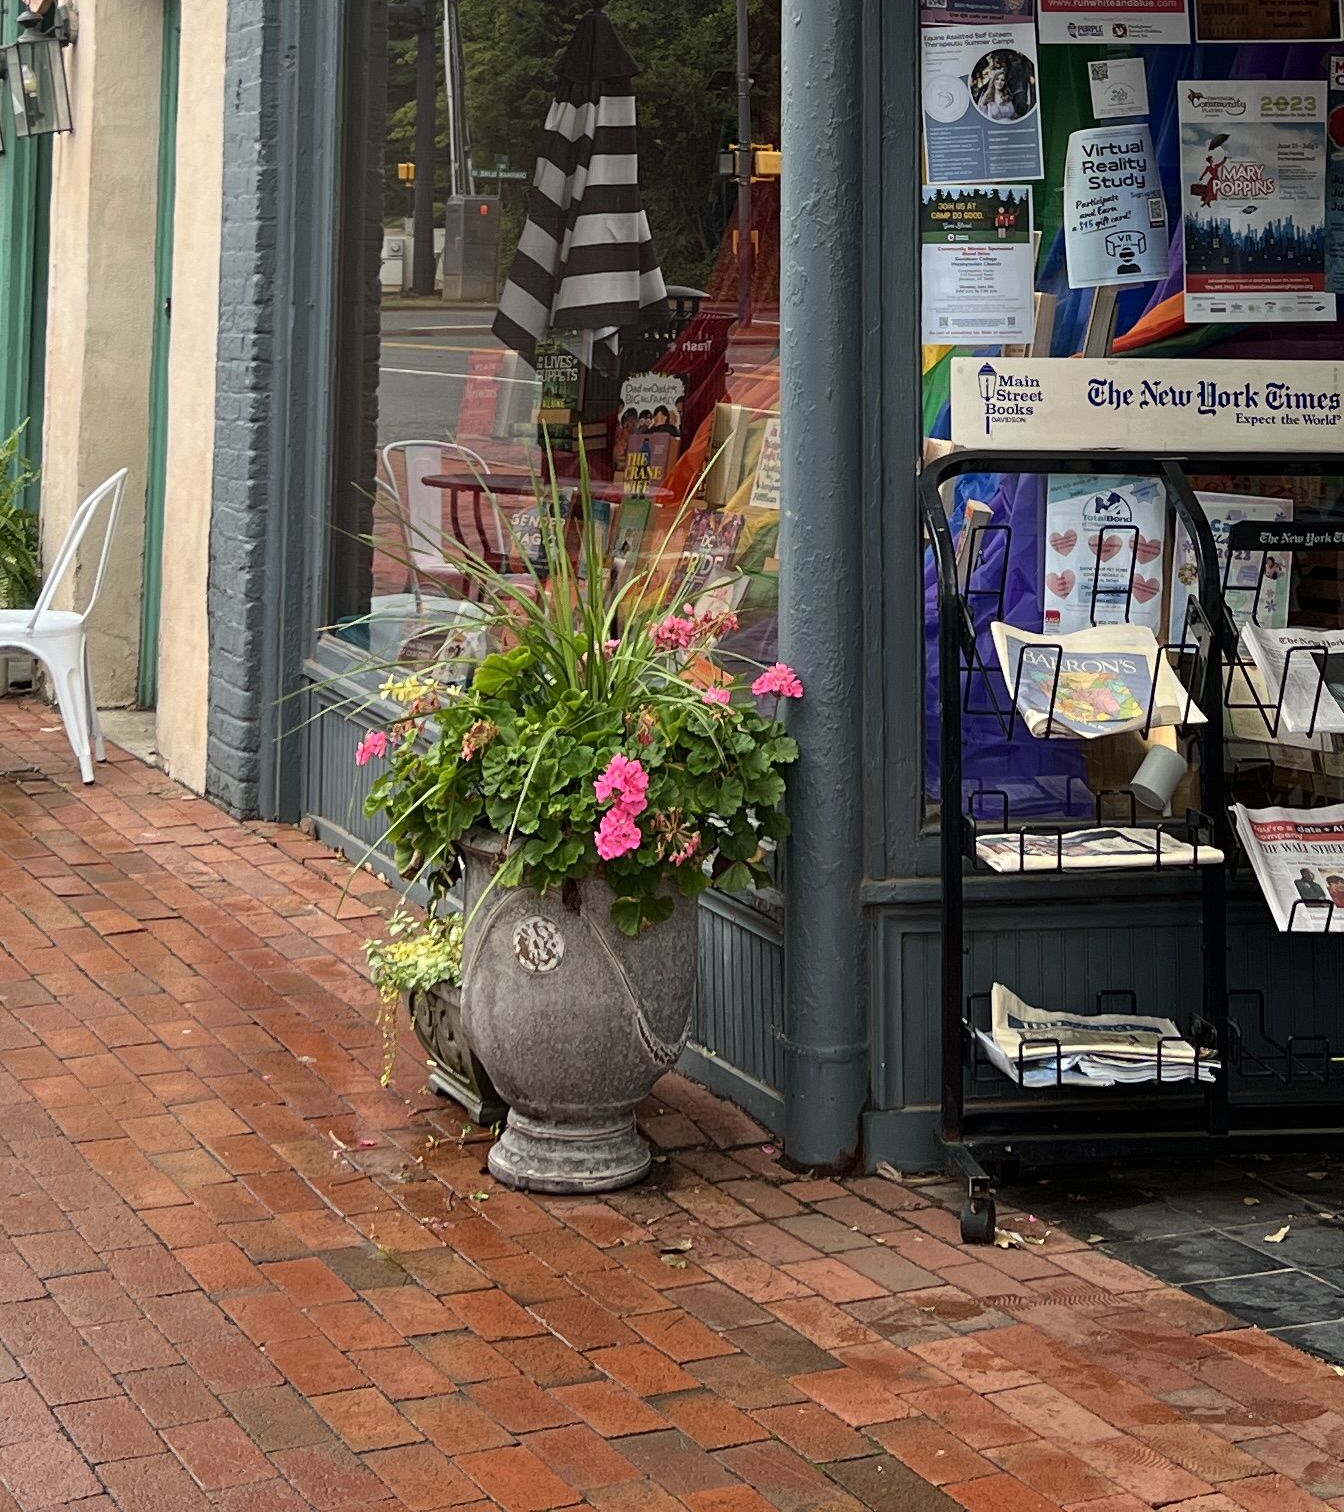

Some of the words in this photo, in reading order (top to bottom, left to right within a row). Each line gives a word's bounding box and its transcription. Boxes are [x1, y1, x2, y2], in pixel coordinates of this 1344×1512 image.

[974, 31, 987, 39] Self
[1078, 25, 1104, 34] PURPLE
[924, 40, 963, 48] Therapeutic
[991, 38, 1015, 47] Camps
[1260, 95, 1317, 111] 2023
[1081, 139, 1145, 158] Virtual
[1082, 157, 1147, 174] Reality
[1220, 164, 1265, 181] MARY
[1088, 173, 1146, 190] Study
[1212, 178, 1276, 199] POPPINS
[937, 202, 955, 210] JOIN
[956, 202, 966, 210] US
[967, 202, 977, 210] AT
[1075, 194, 1119, 210] Participate
[930, 211, 951, 220] CAMP
[952, 212, 963, 220] DO
[1080, 210, 1096, 219] and
[1097, 206, 1118, 217] Earn
[1079, 219, 1094, 231] $15
[1095, 217, 1110, 230] gift
[544, 355, 573, 369] LIVES
[535, 368, 579, 382] PUPPETS
[999, 375, 1040, 388] Main
[625, 383, 643, 394] Dad
[996, 388, 1044, 402] Street
[625, 394, 641, 405] BIG
[648, 394, 677, 405] FAMILY
[1087, 377, 1136, 411] The
[1139, 379, 1194, 411] New
[1196, 379, 1260, 417] York
[1264, 381, 1342, 412] Times
[985, 402, 1034, 416] Books
[1235, 412, 1276, 427] Expect
[1280, 413, 1301, 425] the
[626, 452, 649, 467] THE
[624, 465, 663, 481] CRANE
[623, 480, 652, 494] WIFE
[510, 513, 566, 530] GENDER
[1083, 514, 1132, 523] TotalBond
[1258, 532, 1275, 544] The
[1279, 532, 1304, 544] New
[1305, 532, 1332, 547] York
[1279, 637, 1299, 646] The
[1022, 649, 1137, 674] BARRON'S
[1296, 824, 1323, 834] data
[1279, 841, 1309, 854] WALL
